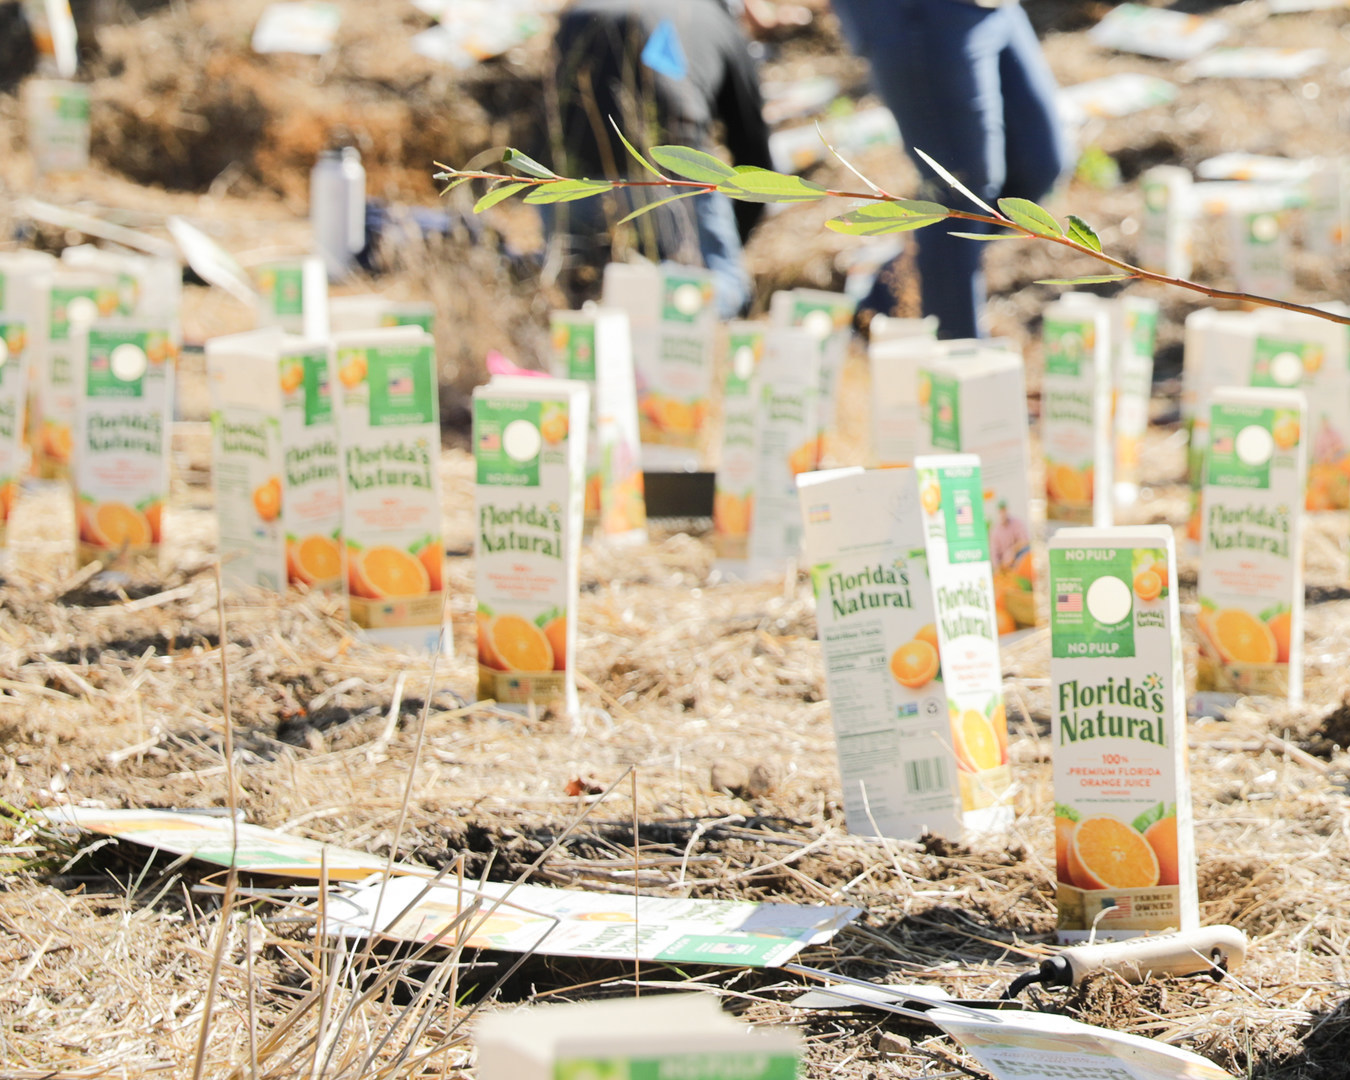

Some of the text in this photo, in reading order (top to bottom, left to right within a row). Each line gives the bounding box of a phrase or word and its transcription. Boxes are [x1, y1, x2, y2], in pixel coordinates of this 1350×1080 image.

[347, 467, 432, 494] Natural
[481, 502, 561, 533] Florida's
[481, 530, 562, 559] Natural
[1065, 550, 1116, 561] NO PULP
[1209, 530, 1289, 558] Natural
[829, 565, 910, 596] Florida's
[833, 589, 914, 620] Natural
[1068, 642, 1119, 654] NO PULP
[1059, 676, 1165, 714] Florida's
[1059, 709, 1166, 748] Natural
[1069, 767, 1162, 777] PREMIUM FLORIDA
[1102, 754, 1129, 765] 100%
[1080, 778, 1151, 788] ORANGE JUICE
